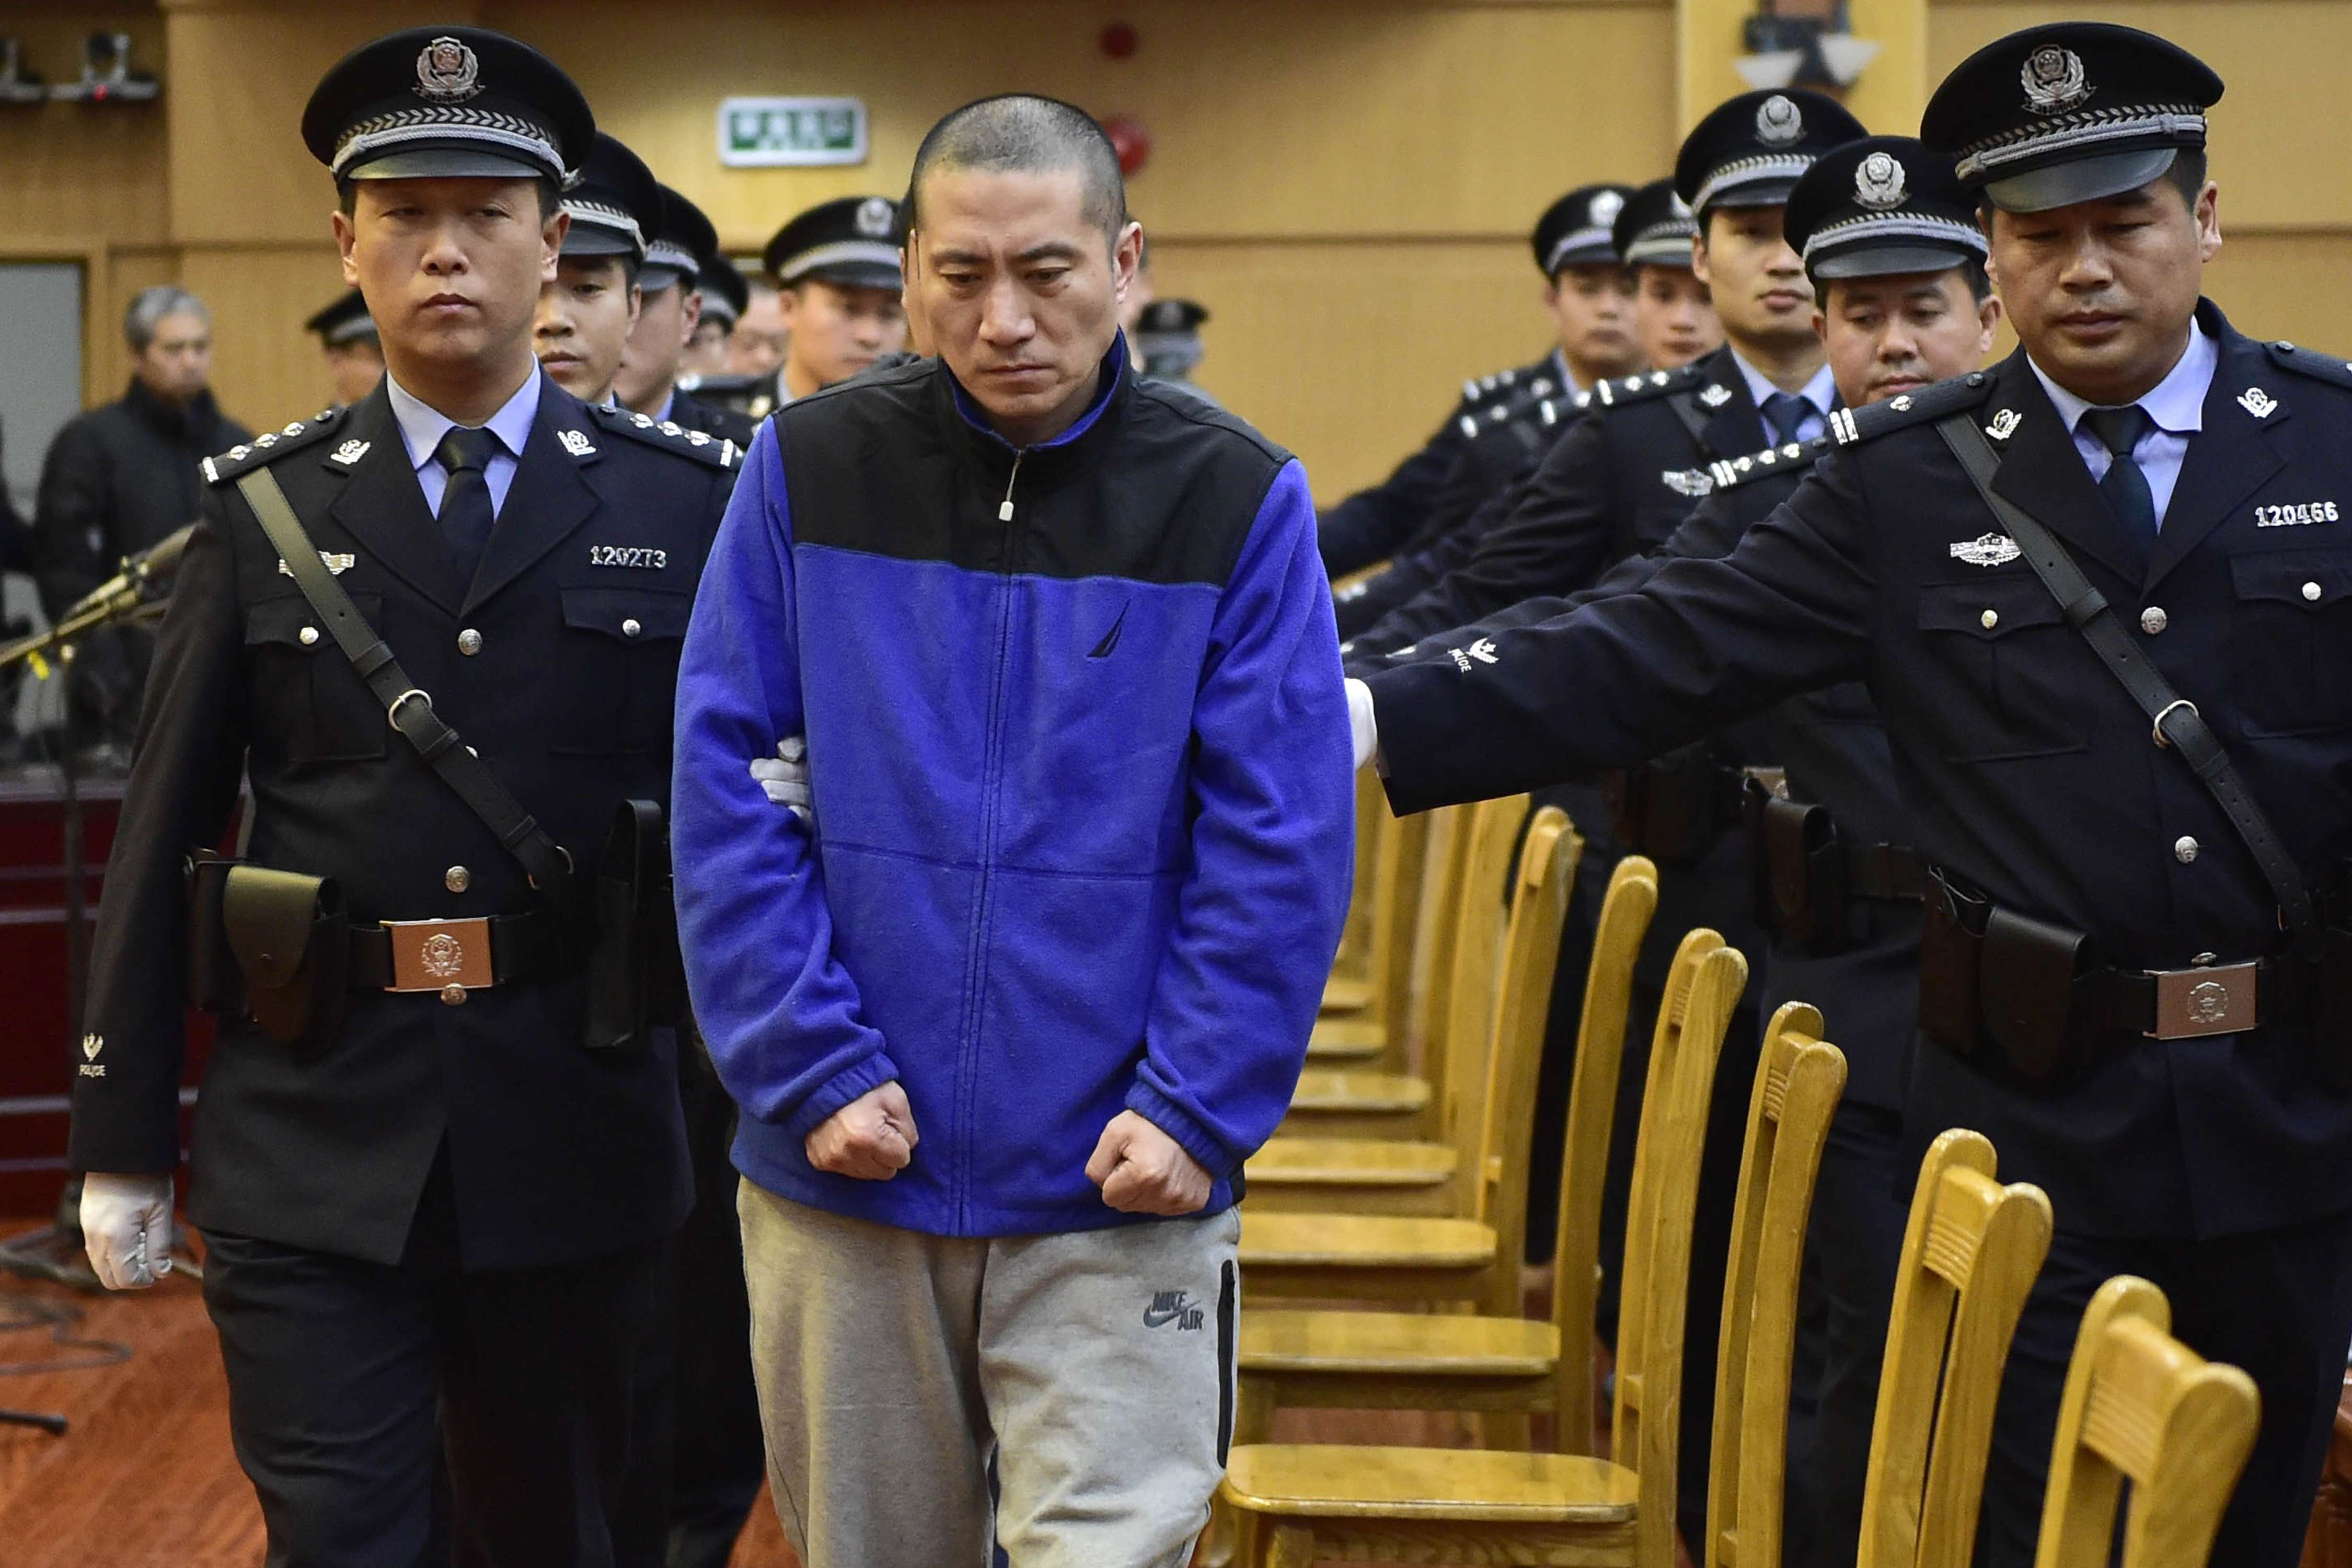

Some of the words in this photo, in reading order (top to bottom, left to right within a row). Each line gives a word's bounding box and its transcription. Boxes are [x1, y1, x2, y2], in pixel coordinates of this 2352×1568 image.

[2255, 501, 2339, 527] 120466
[590, 545, 667, 569] 120273
[1151, 1290, 1188, 1312] NIKE
[1177, 1309, 1204, 1331] AIR
